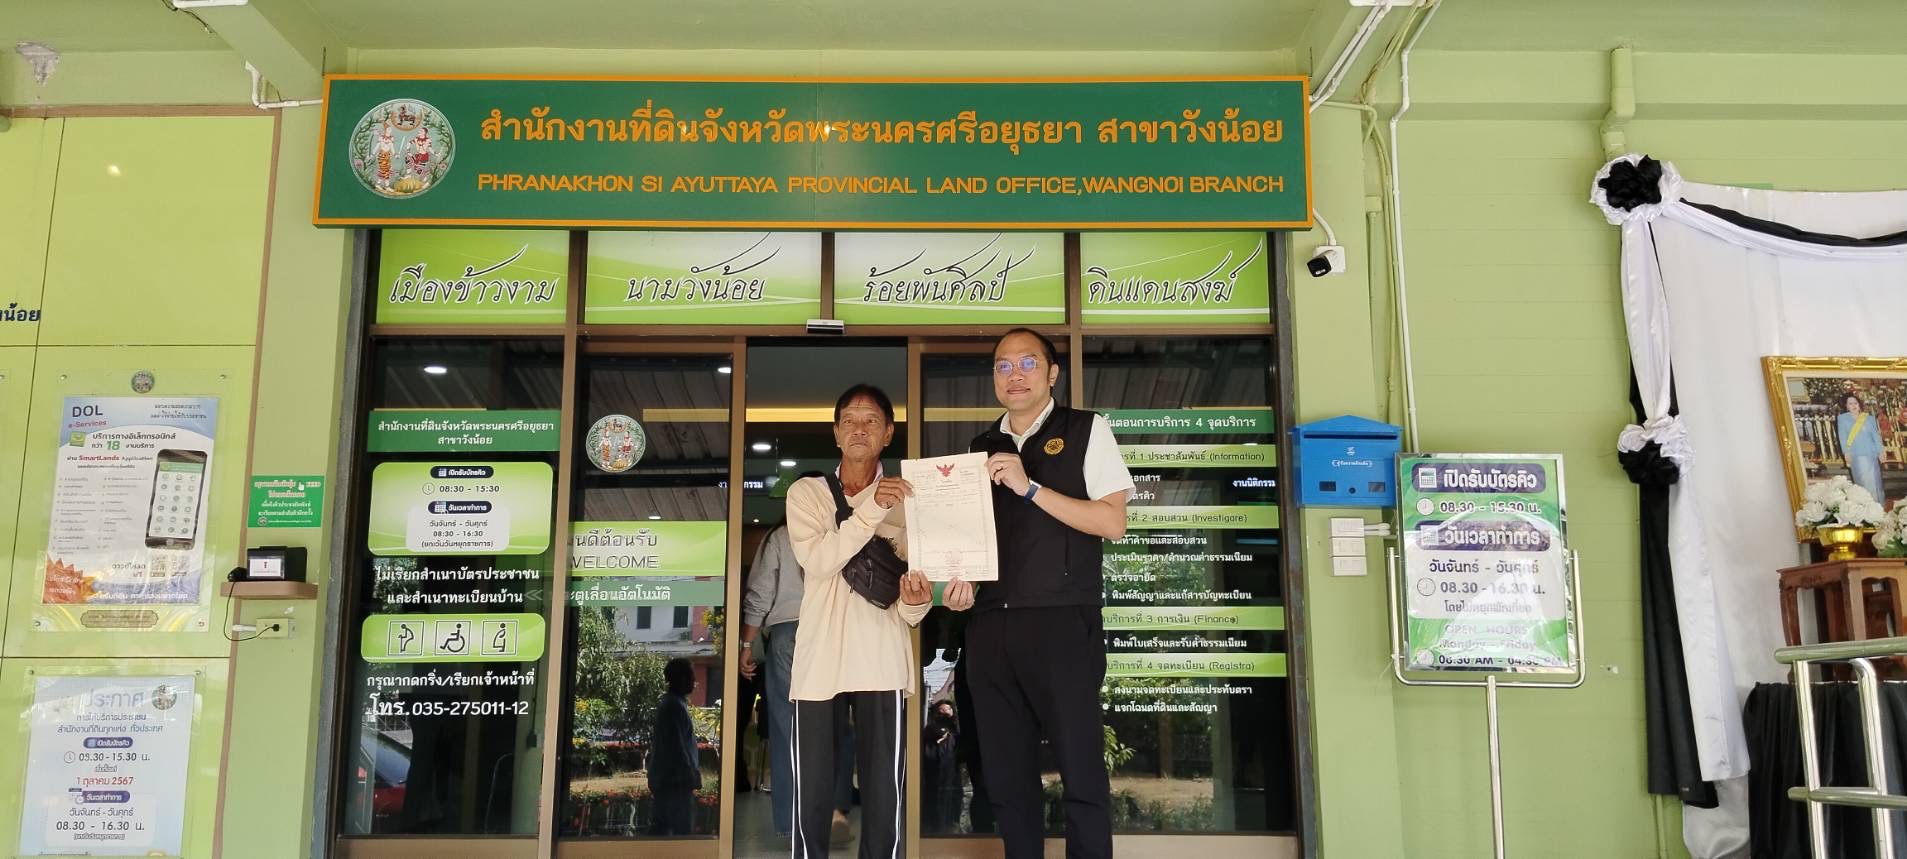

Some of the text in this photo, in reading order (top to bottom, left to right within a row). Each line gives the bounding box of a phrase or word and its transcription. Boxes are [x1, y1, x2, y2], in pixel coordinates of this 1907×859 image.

[481, 100, 1283, 155] สำนักงานที่ดินจังหวัดพระนครศรีอยุธยา สาขาวังน้อย
[478, 174, 633, 192] PHRANAKHON
[641, 175, 664, 192] SI
[671, 175, 778, 193] AYUTTAYA
[788, 175, 918, 193] PROVINCIAL
[927, 176, 987, 193] LAND
[1190, 175, 1284, 193] BRANCH
[388, 243, 560, 304] เมืองข้าวงาม
[624, 231, 781, 302] นามวังน้อย
[862, 232, 1038, 303] ร้อยพันศิลป์
[1086, 236, 1264, 304] ดินแดนสงฆ์
[0, 302, 41, 322] น้อย
[72, 405, 104, 417] DOL
[378, 418, 554, 434] สำนักงานที่ดินจังหวัดพระนครศรีอยุธยา
[1104, 413, 1256, 430] ั้นตอนการบริการ 4 จุดบริการ
[106, 440, 120, 450] 18
[438, 433, 493, 445] สาขาวังน้อย
[1148, 450, 1207, 461] ประชาสัมพันธ์
[1209, 452, 1266, 462] (Information)
[1443, 468, 1537, 488] เปิดรับบัตรคิว
[439, 485, 464, 493] 08:30
[476, 485, 500, 493] 15:30
[1440, 502, 1475, 513] 08.30
[1142, 514, 1148, 522] 2
[1152, 514, 1189, 523] สอบสวน
[572, 528, 658, 547] นดีต้อนรับ
[1444, 525, 1541, 545] วันเวลาทำการ
[375, 565, 540, 581] ไม่เรียกสำเนาบัตรประชาชน
[1429, 559, 1480, 573] วันจันทร์
[570, 582, 671, 606] ะตูเลื่อนอัตโนมัติ
[1440, 581, 1478, 593] 08.30
[387, 589, 523, 604] และสำเนาทะเบียนบ้าน
[1146, 615, 1153, 623] 3
[1157, 613, 1190, 624] การเงิน
[1147, 662, 1153, 670] 4
[1158, 661, 1205, 670] จดทะเบียน
[370, 692, 529, 716] โทร. 035-275011-12
[112, 752, 137, 762] 15.30
[112, 776, 134, 785] 2567
[56, 821, 85, 831] 08.30
[102, 821, 130, 831] 16.30
